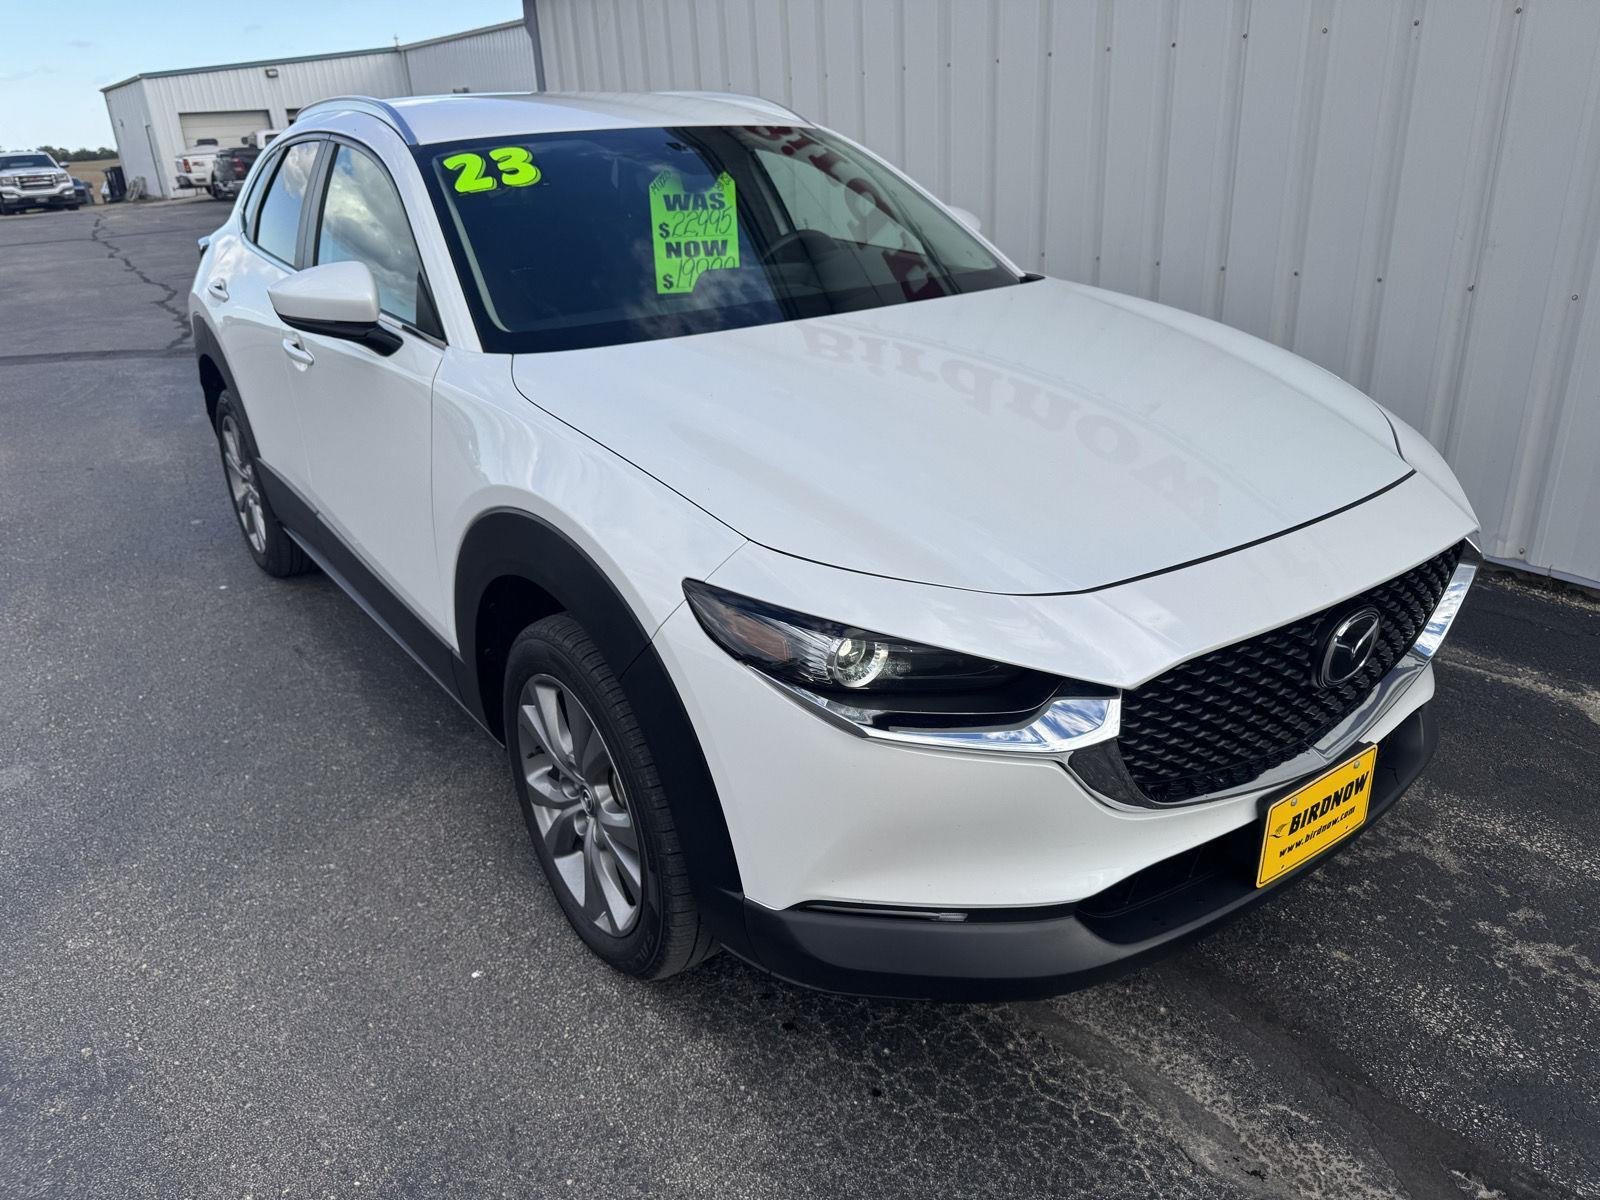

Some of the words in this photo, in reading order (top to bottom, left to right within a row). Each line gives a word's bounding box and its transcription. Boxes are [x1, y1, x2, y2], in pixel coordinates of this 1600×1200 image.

[443, 146, 541, 194] 23
[663, 192, 726, 211] WAS
[665, 239, 728, 259] NOW
[1288, 771, 1370, 836] BIRDNOW
[1279, 806, 1356, 858] www.birdnow.com
